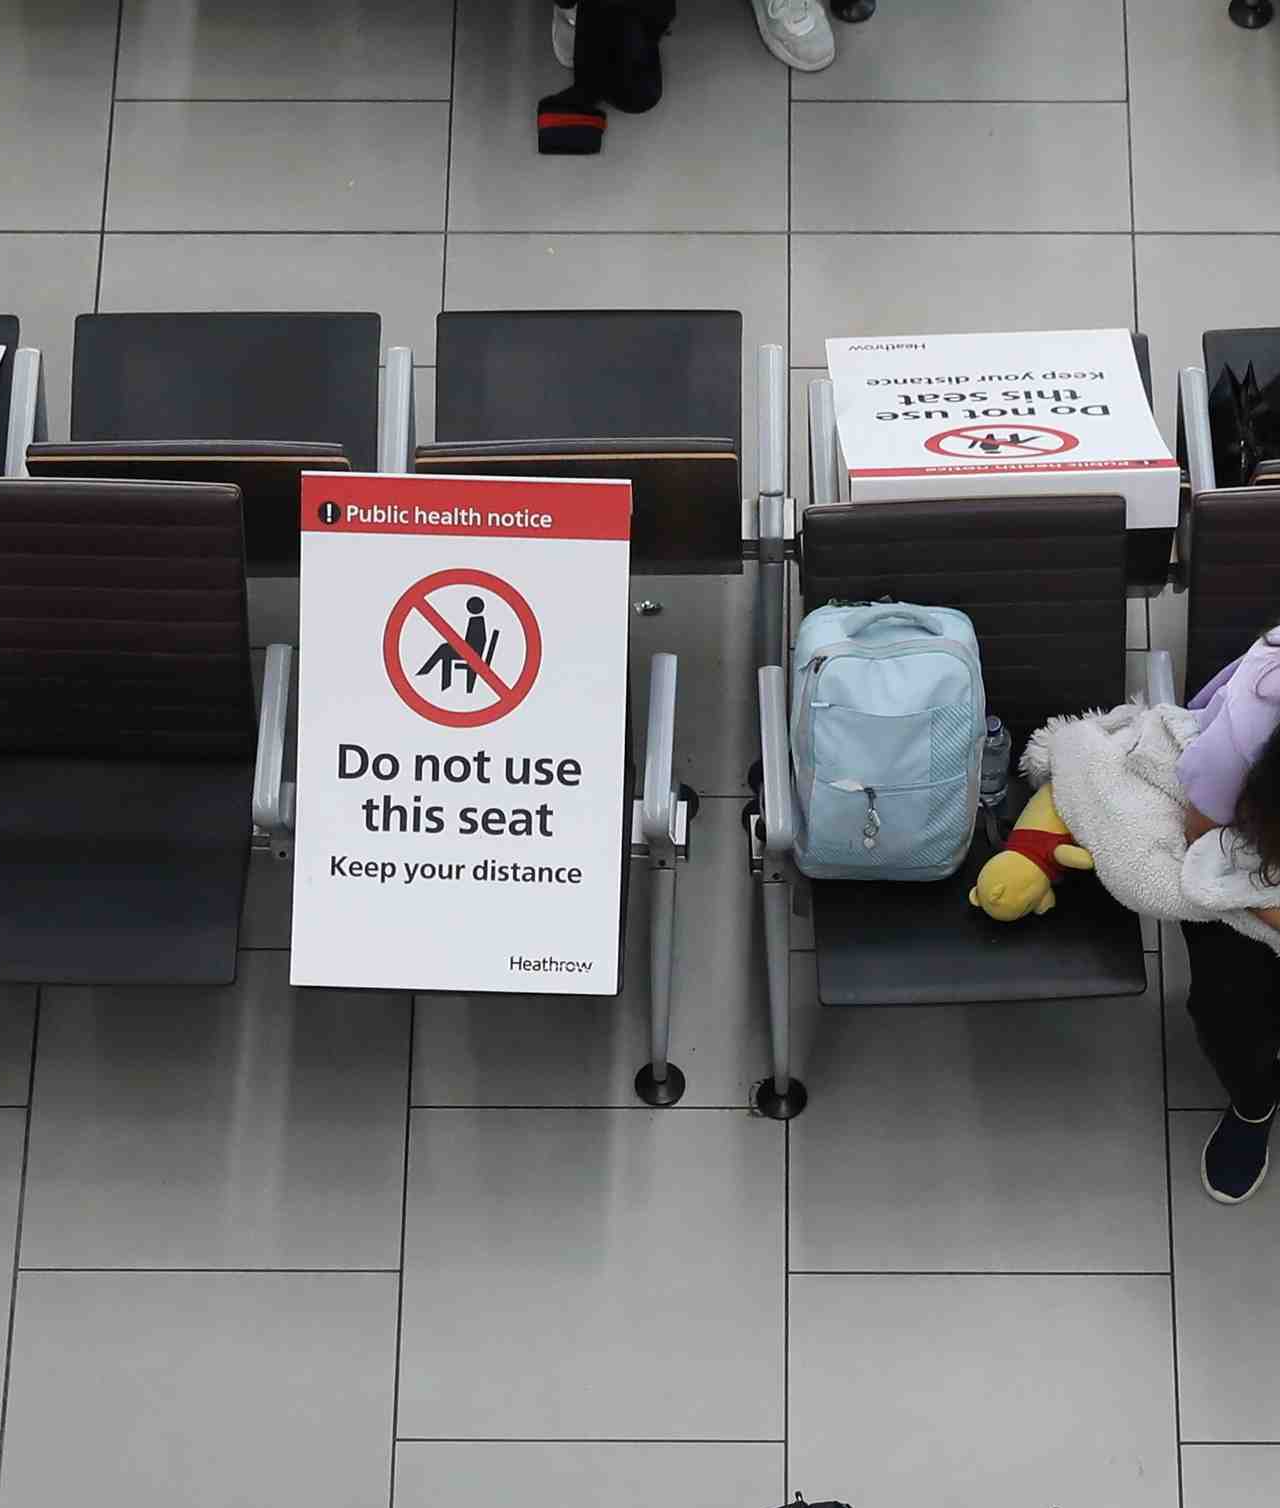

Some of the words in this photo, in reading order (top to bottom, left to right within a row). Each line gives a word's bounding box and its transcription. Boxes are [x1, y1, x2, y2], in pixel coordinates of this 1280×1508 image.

[848, 342, 926, 353] Heathrow
[866, 375, 970, 386] distance
[976, 371, 1035, 383] your
[1041, 370, 1105, 381] Keep
[897, 391, 988, 407] seat
[1001, 388, 1081, 404] this
[875, 409, 950, 421] use
[962, 407, 1036, 420] not
[1050, 404, 1111, 417] Do
[347, 505, 408, 523] Public
[415, 507, 480, 525] health
[488, 510, 552, 527] notice
[338, 744, 399, 780] Do
[415, 750, 491, 784] not
[506, 757, 581, 786] use
[362, 795, 444, 833] this
[459, 804, 553, 837] seat
[331, 856, 396, 883] Keep
[404, 863, 466, 884] your
[473, 860, 582, 883] distance
[510, 956, 592, 973] Heathrow
